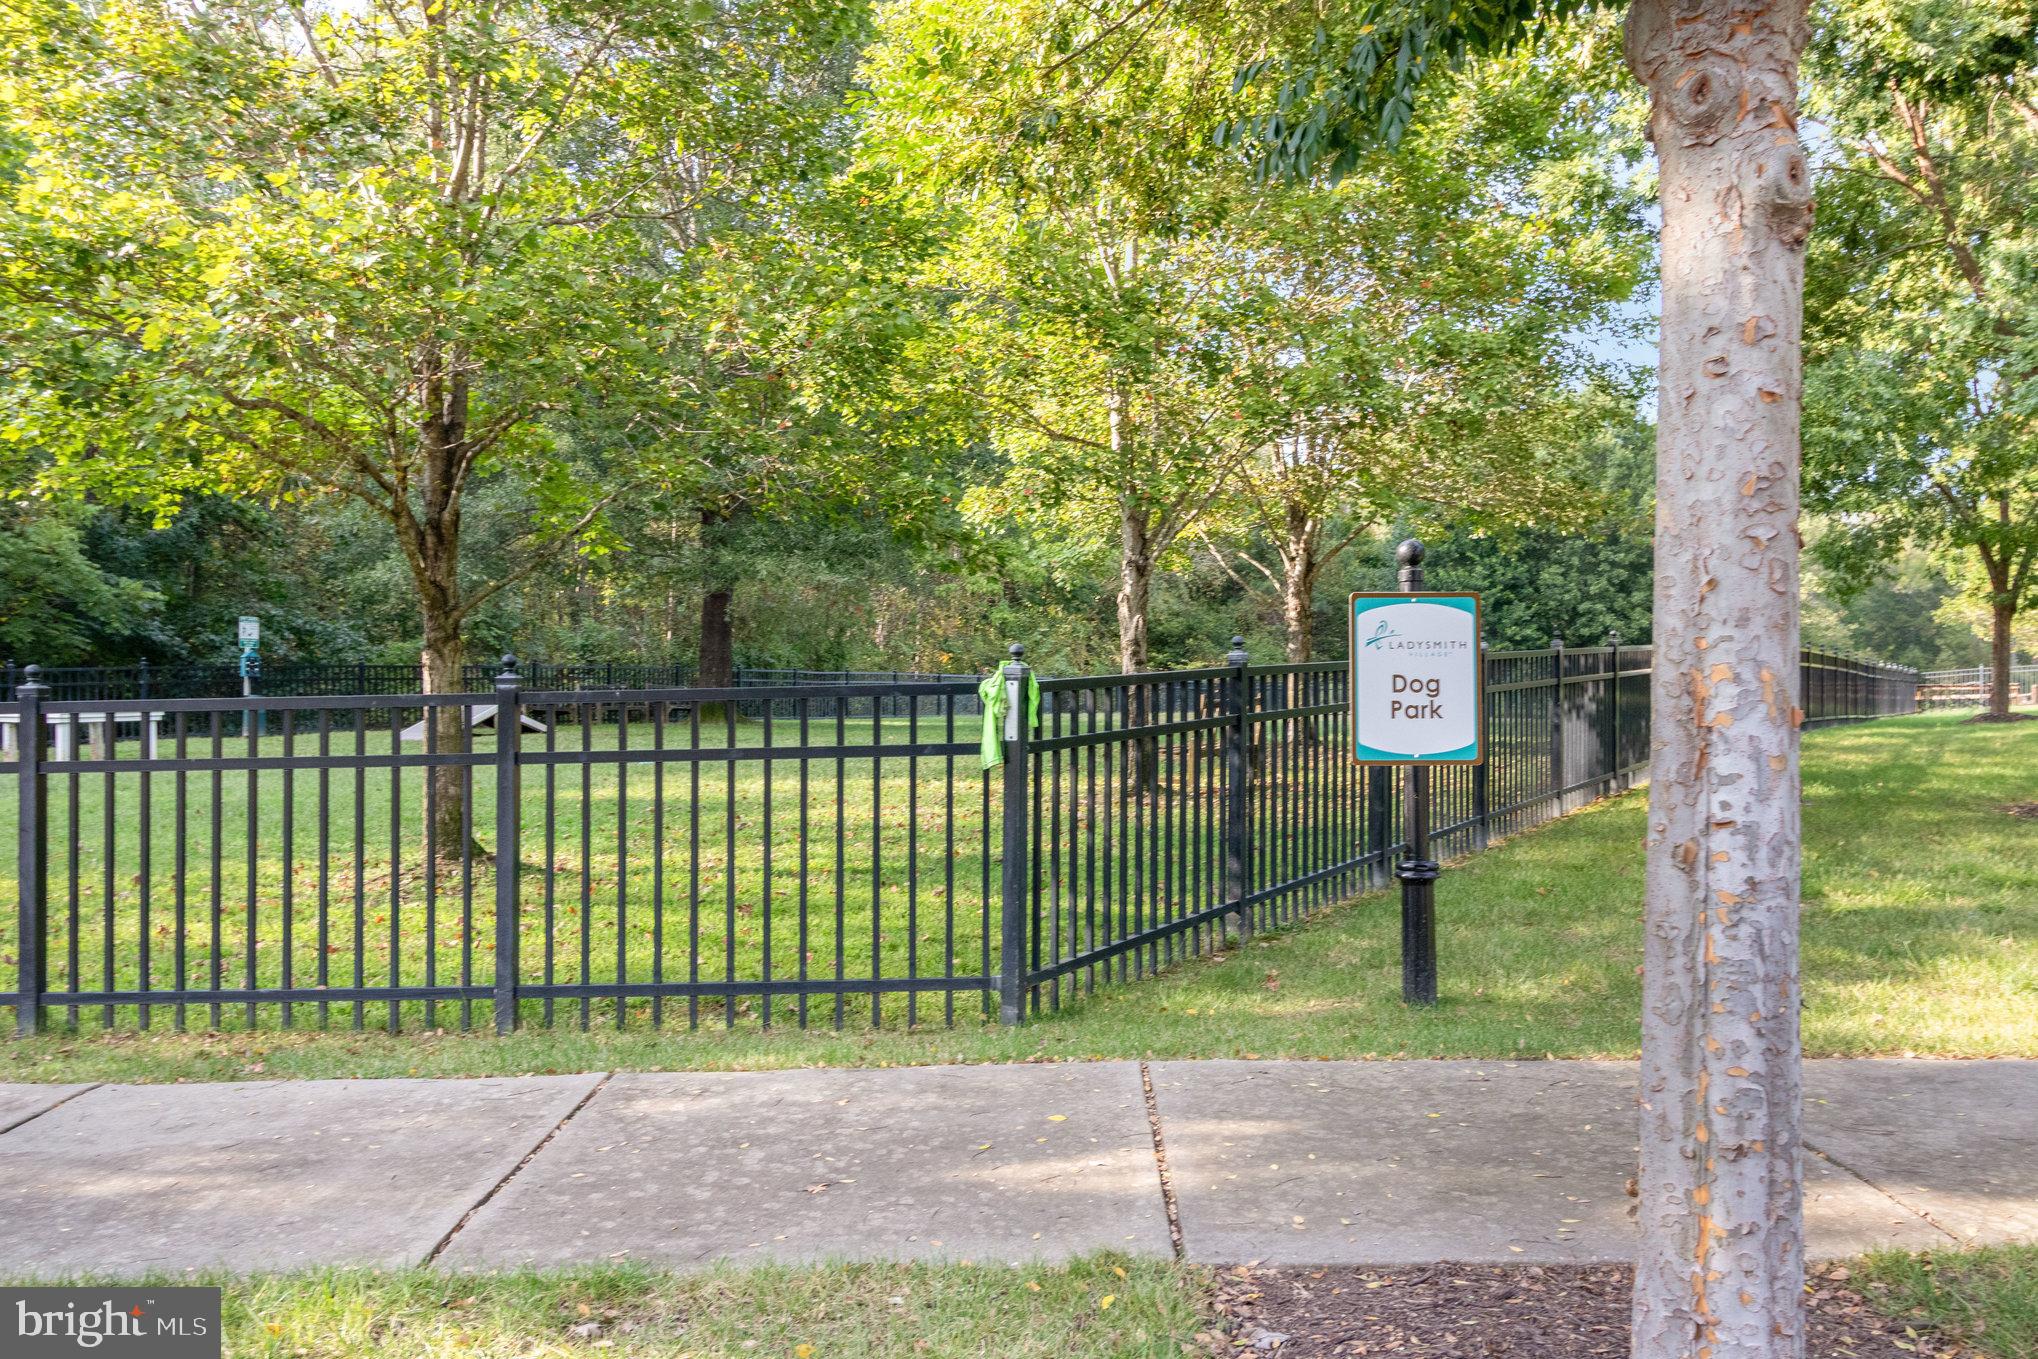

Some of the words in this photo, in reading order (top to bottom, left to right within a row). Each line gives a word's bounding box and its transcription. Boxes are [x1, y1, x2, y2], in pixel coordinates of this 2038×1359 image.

[1388, 640, 1468, 650] LADYSMITH
[1392, 674, 1440, 698] Dog
[1391, 700, 1443, 719] Park
